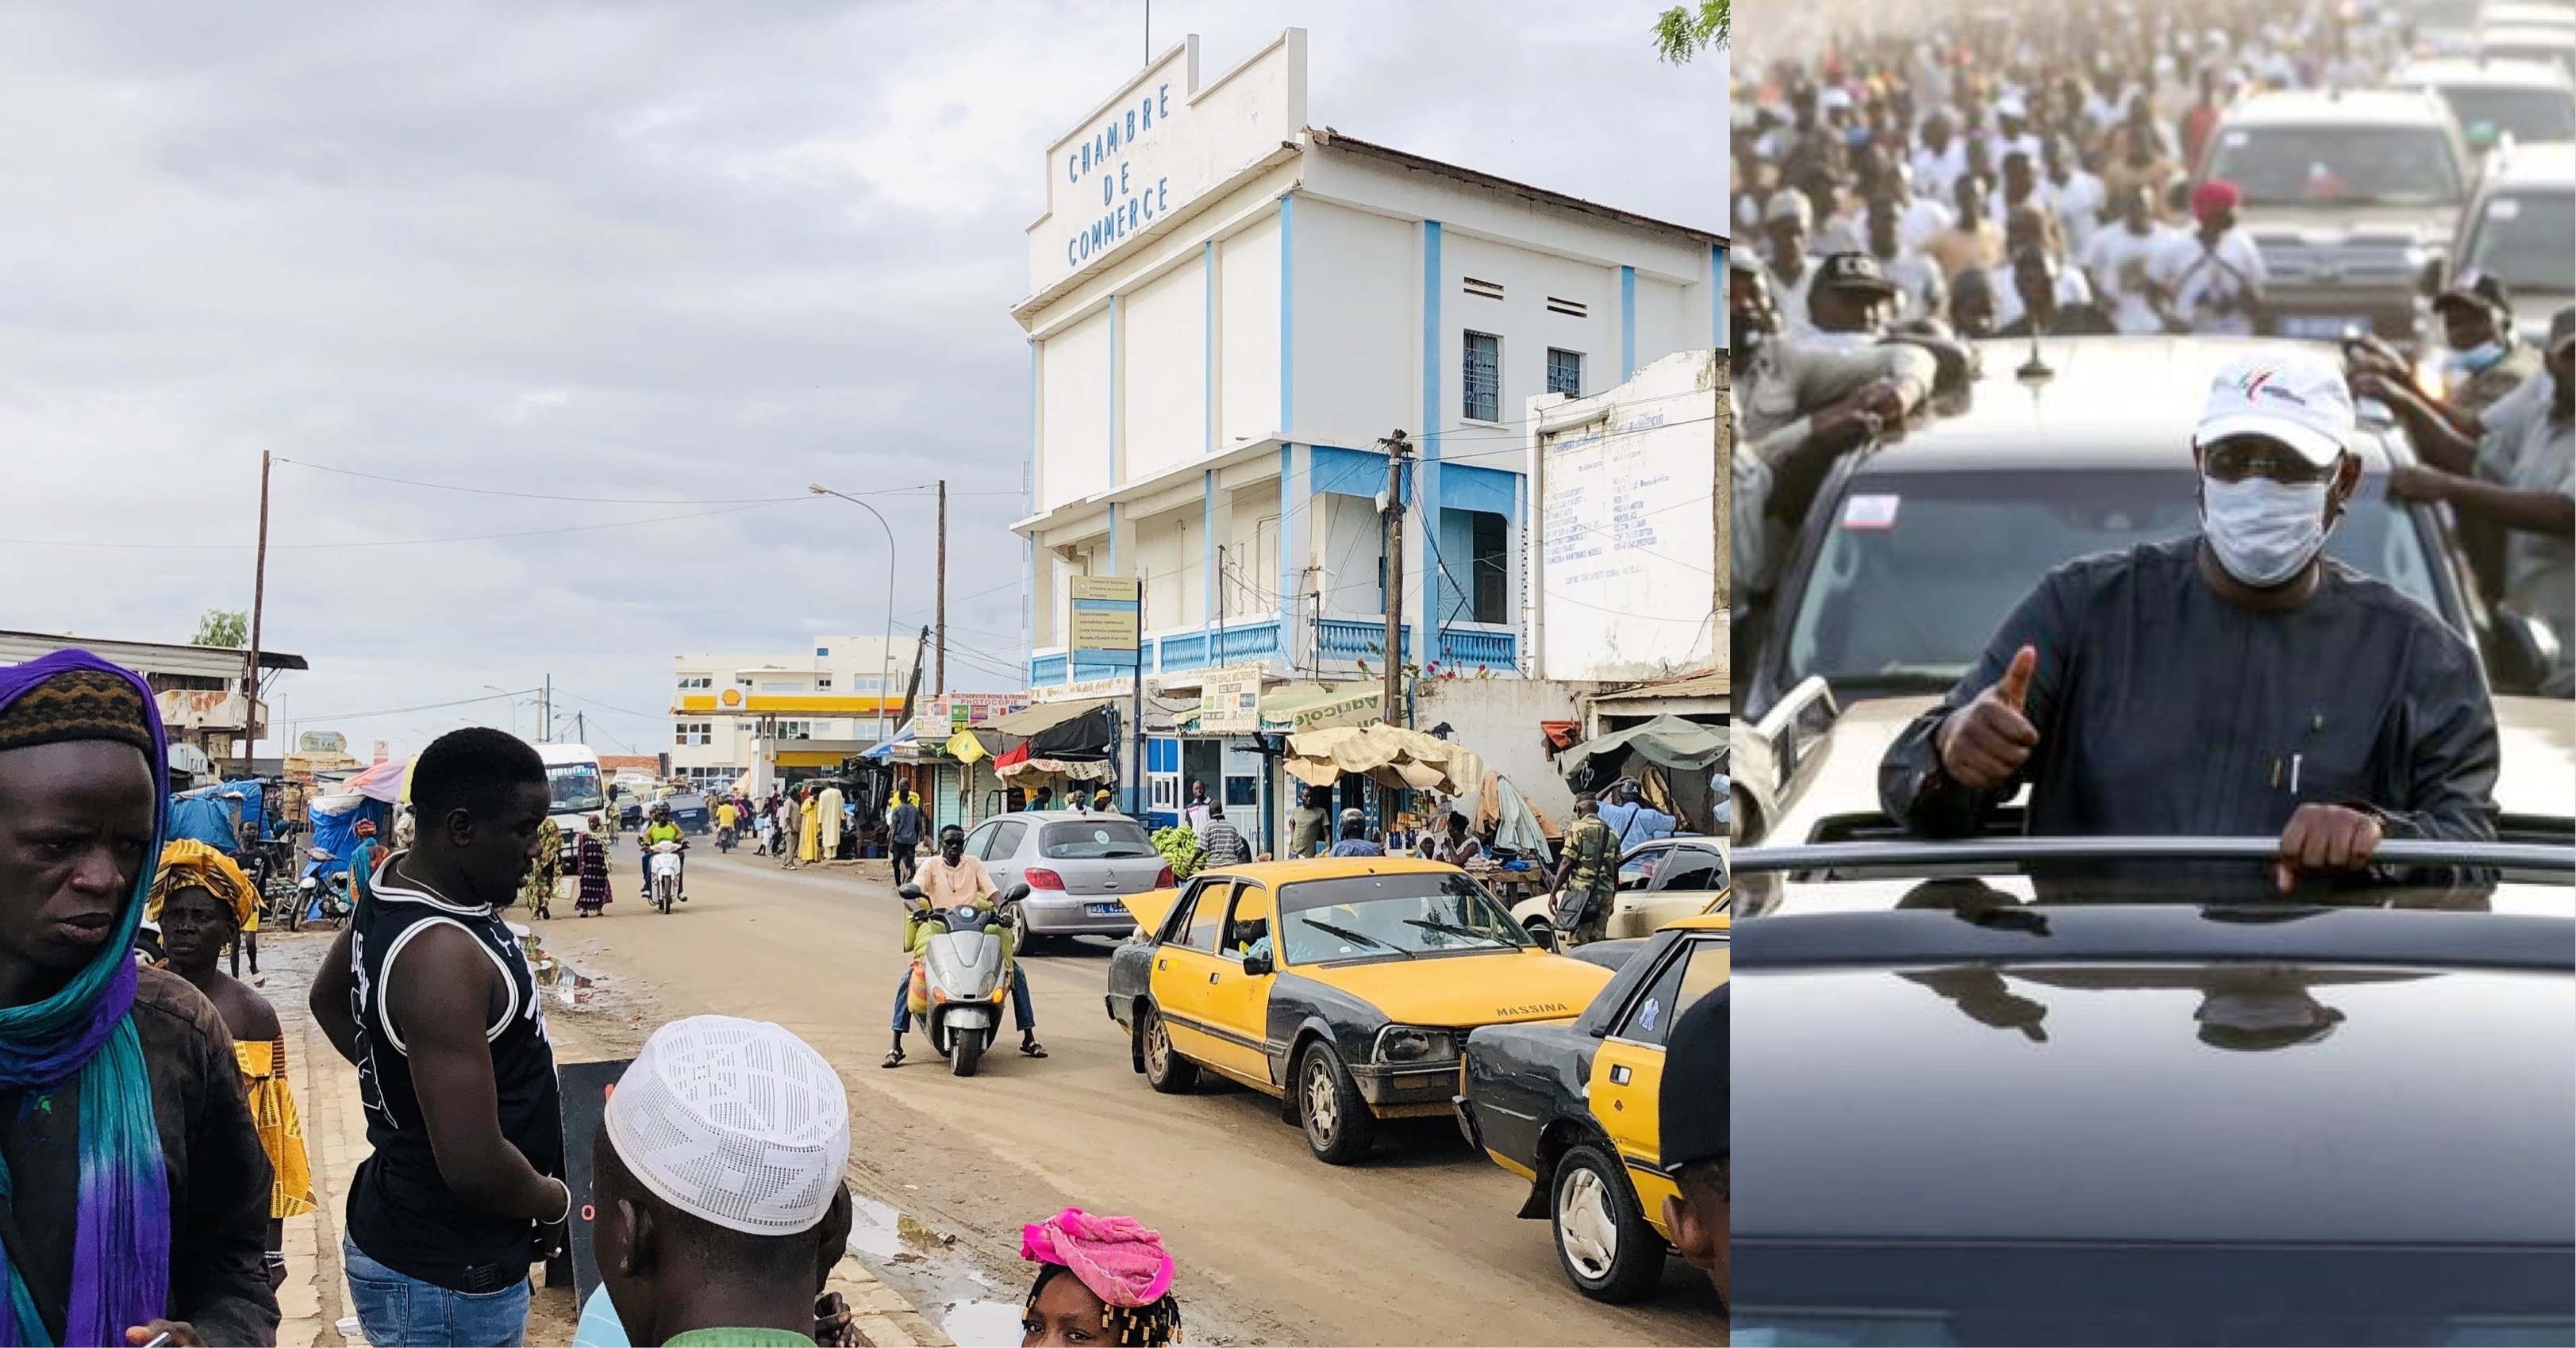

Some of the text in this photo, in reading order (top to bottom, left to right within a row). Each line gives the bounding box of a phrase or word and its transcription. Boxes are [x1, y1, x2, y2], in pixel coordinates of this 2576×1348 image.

[1068, 83, 1169, 183] CHAMBRE
[1103, 160, 1129, 206] DE
[1067, 176, 1167, 267] COMMERCE
[1294, 694, 1379, 727] Agricole
[1496, 1002, 1568, 1016] MASSINA
